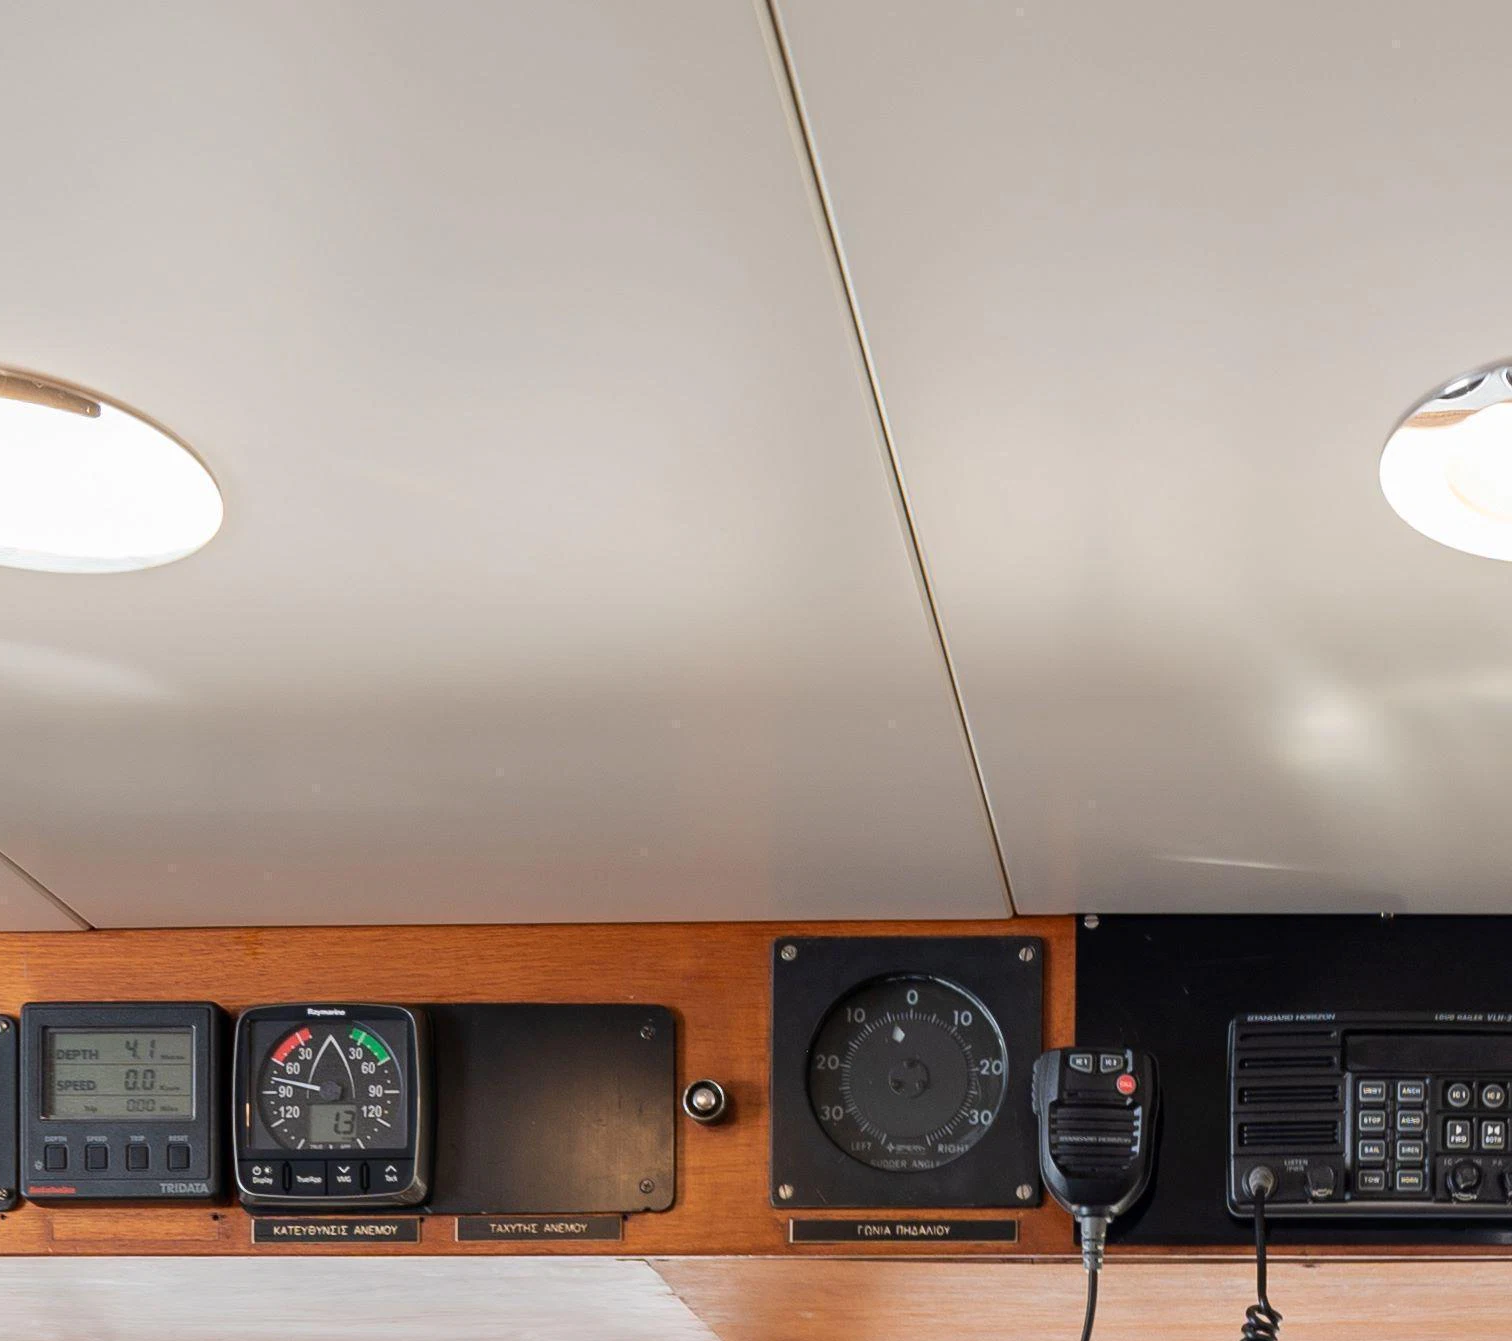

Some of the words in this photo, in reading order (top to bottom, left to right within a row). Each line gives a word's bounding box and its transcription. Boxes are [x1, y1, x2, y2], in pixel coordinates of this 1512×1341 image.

[906, 989, 918, 1005] 0
[846, 1007, 866, 1024] 10
[953, 1010, 973, 1027] 10
[1296, 1013, 1336, 1021] HORIZON
[56, 1048, 99, 1060] DEPTH
[298, 1048, 312, 1060] 30
[348, 1048, 363, 1060] 30
[286, 1062, 300, 1074] 60
[361, 1062, 375, 1074] 60
[816, 1055, 841, 1071] 20
[979, 1059, 1004, 1077] 20
[56, 1079, 98, 1091] SPEED
[278, 1086, 293, 1098] 90
[368, 1086, 383, 1098] 90
[279, 1105, 300, 1118] 120
[362, 1105, 383, 1118] 120
[820, 1105, 844, 1121] 30
[968, 1109, 993, 1126] 30
[850, 1142, 872, 1152] LEFT
[937, 1143, 970, 1154] RIGHT
[160, 1183, 209, 1194] TRIDATA
[273, 1225, 349, 1236] ΚΑΤΕΥΘΥΝΣΙΣ
[353, 1224, 399, 1236] ΑΝΕΜΟΥ
[489, 1223, 538, 1234] ΤΑΧΥΤΗΣ
[543, 1222, 588, 1234] ΑΝΕΜΟΥ
[857, 1224, 891, 1236] ΓΩΝΙΑ
[896, 1223, 951, 1236] ΠΗΔΑΛΙΟΥ
